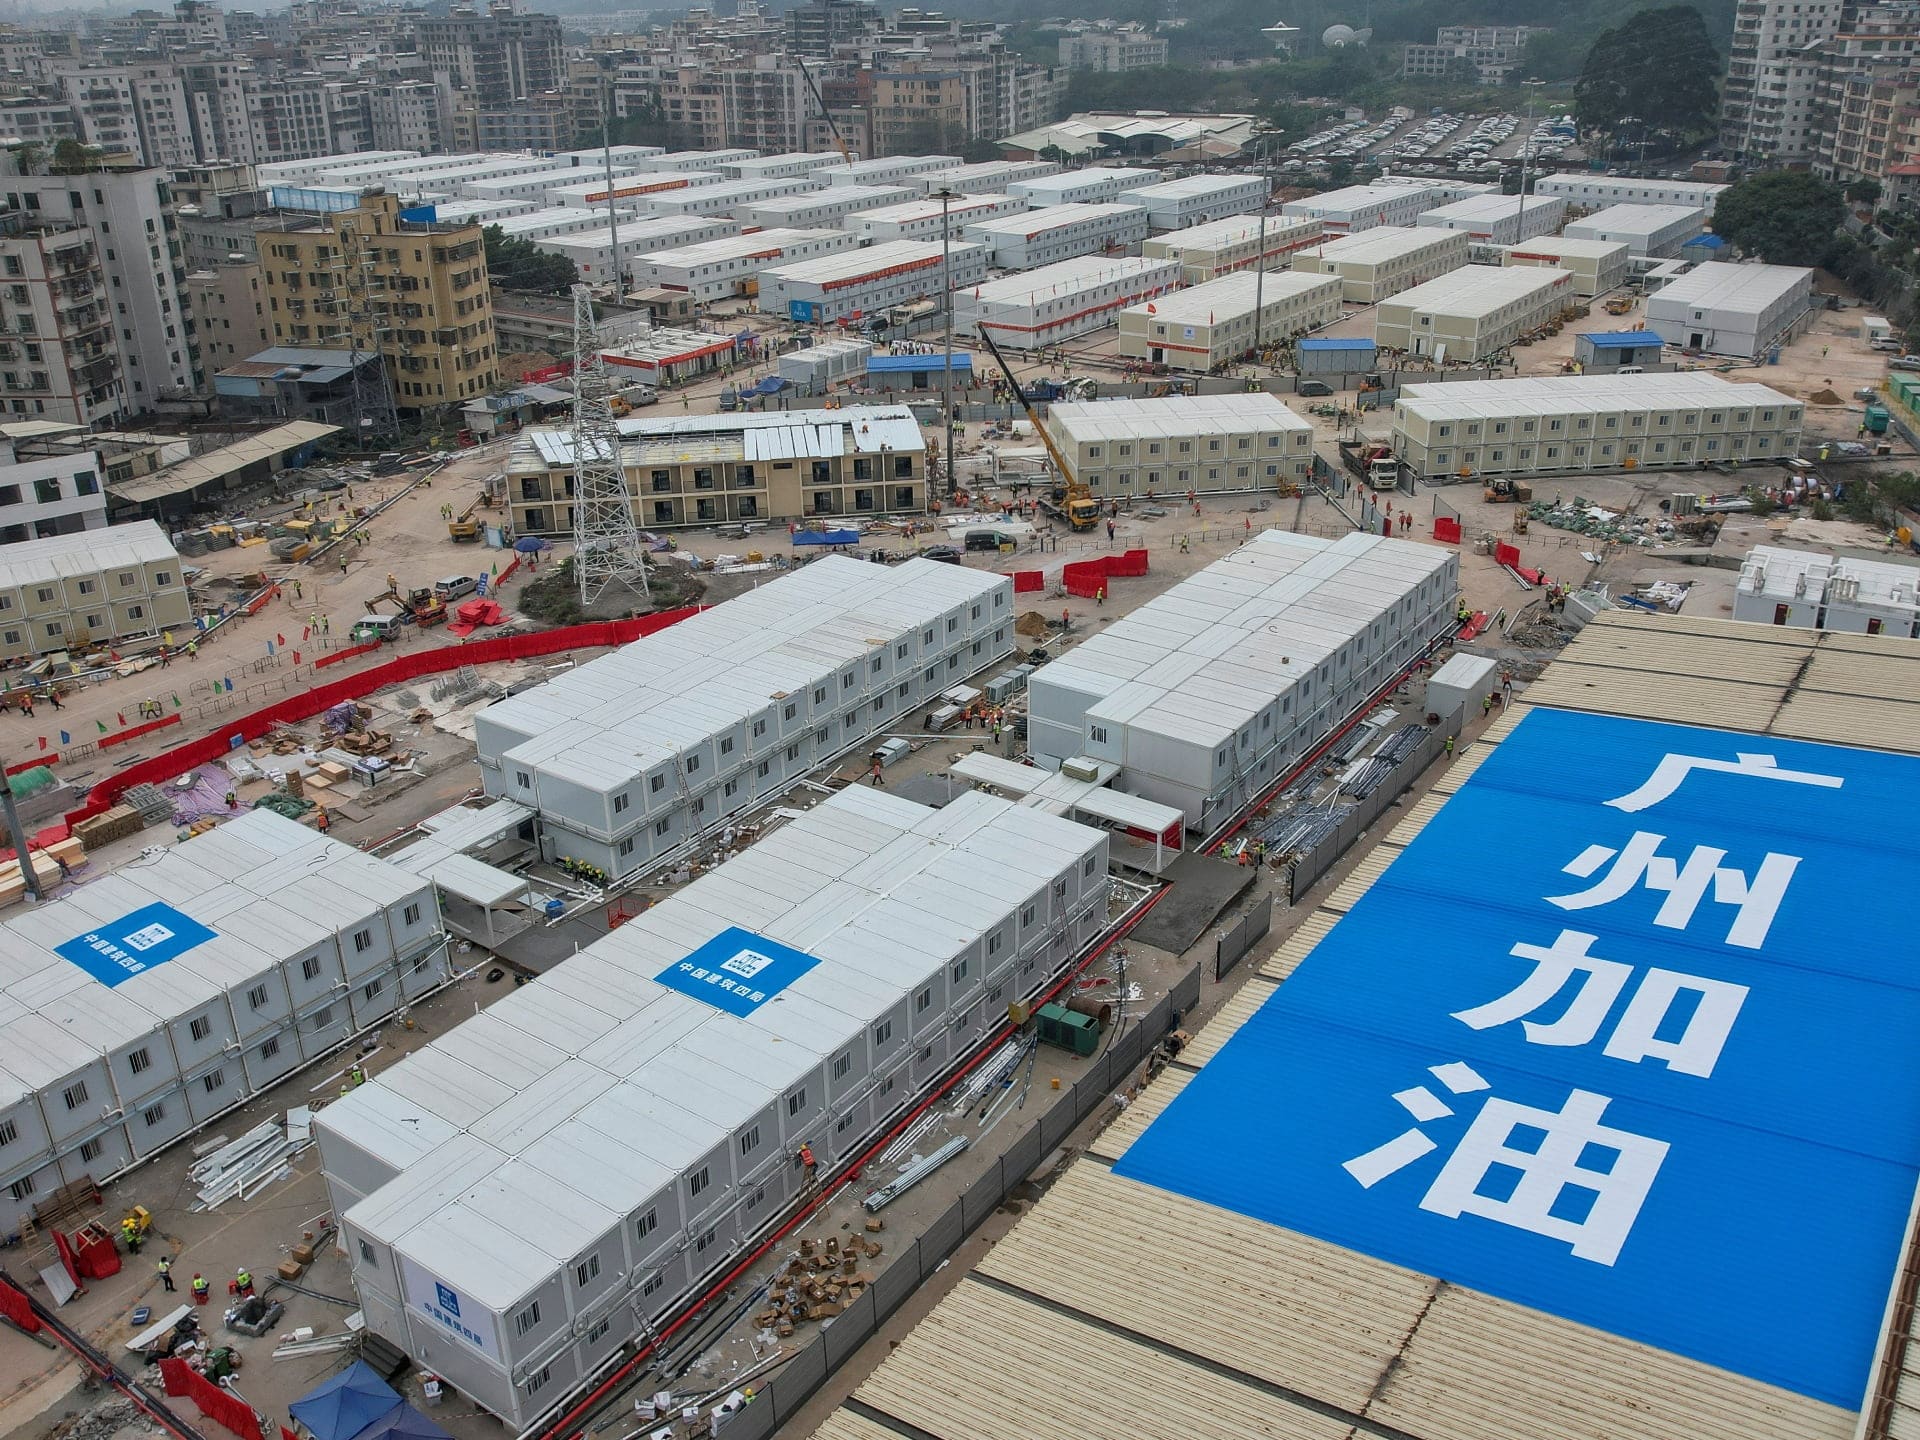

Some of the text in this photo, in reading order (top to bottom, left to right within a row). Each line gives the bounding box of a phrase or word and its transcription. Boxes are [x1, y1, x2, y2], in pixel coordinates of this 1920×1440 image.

[679, 962, 766, 1003] 中国建筑四局
[1341, 752, 1845, 1267] 广州加油
